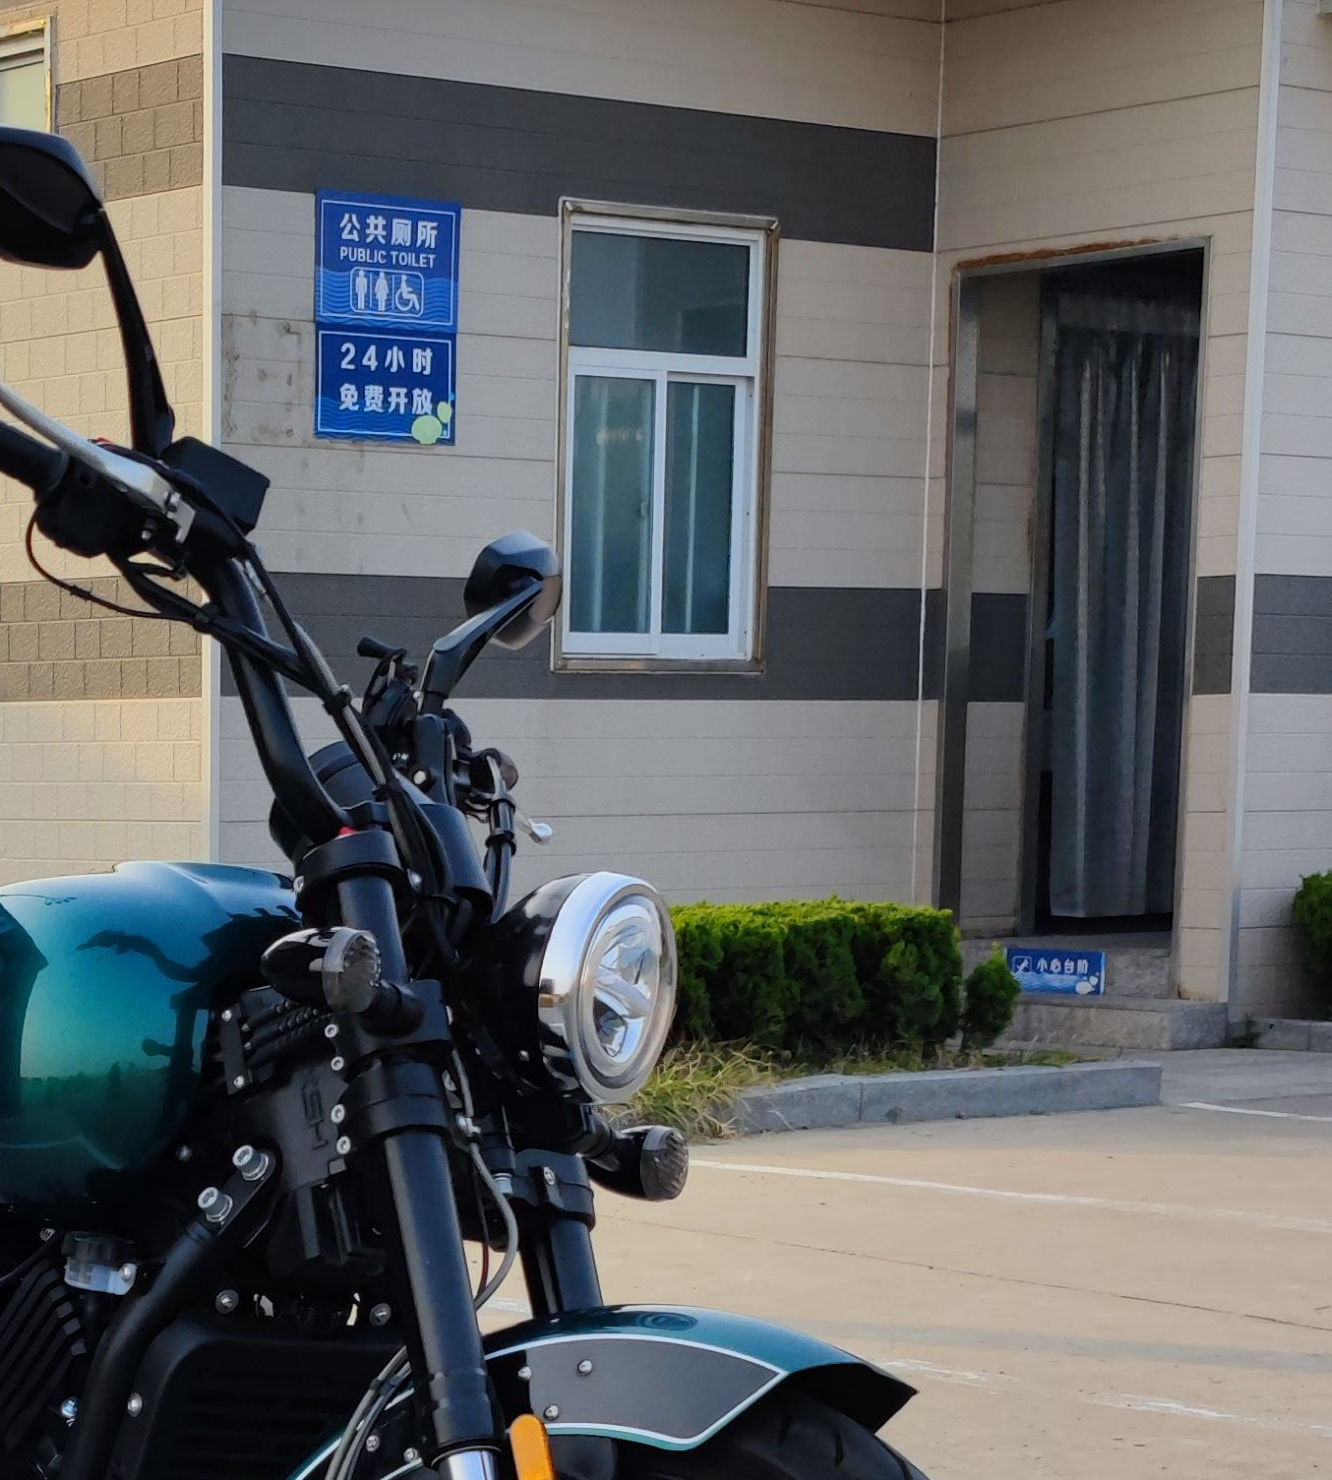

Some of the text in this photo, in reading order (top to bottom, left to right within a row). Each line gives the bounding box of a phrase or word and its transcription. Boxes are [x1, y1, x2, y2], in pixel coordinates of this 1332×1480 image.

[339, 212, 439, 250] 公共厕所
[339, 246, 436, 269] PUBLIC TOILET
[340, 342, 433, 376] 24小时
[339, 383, 434, 416] 免费开放
